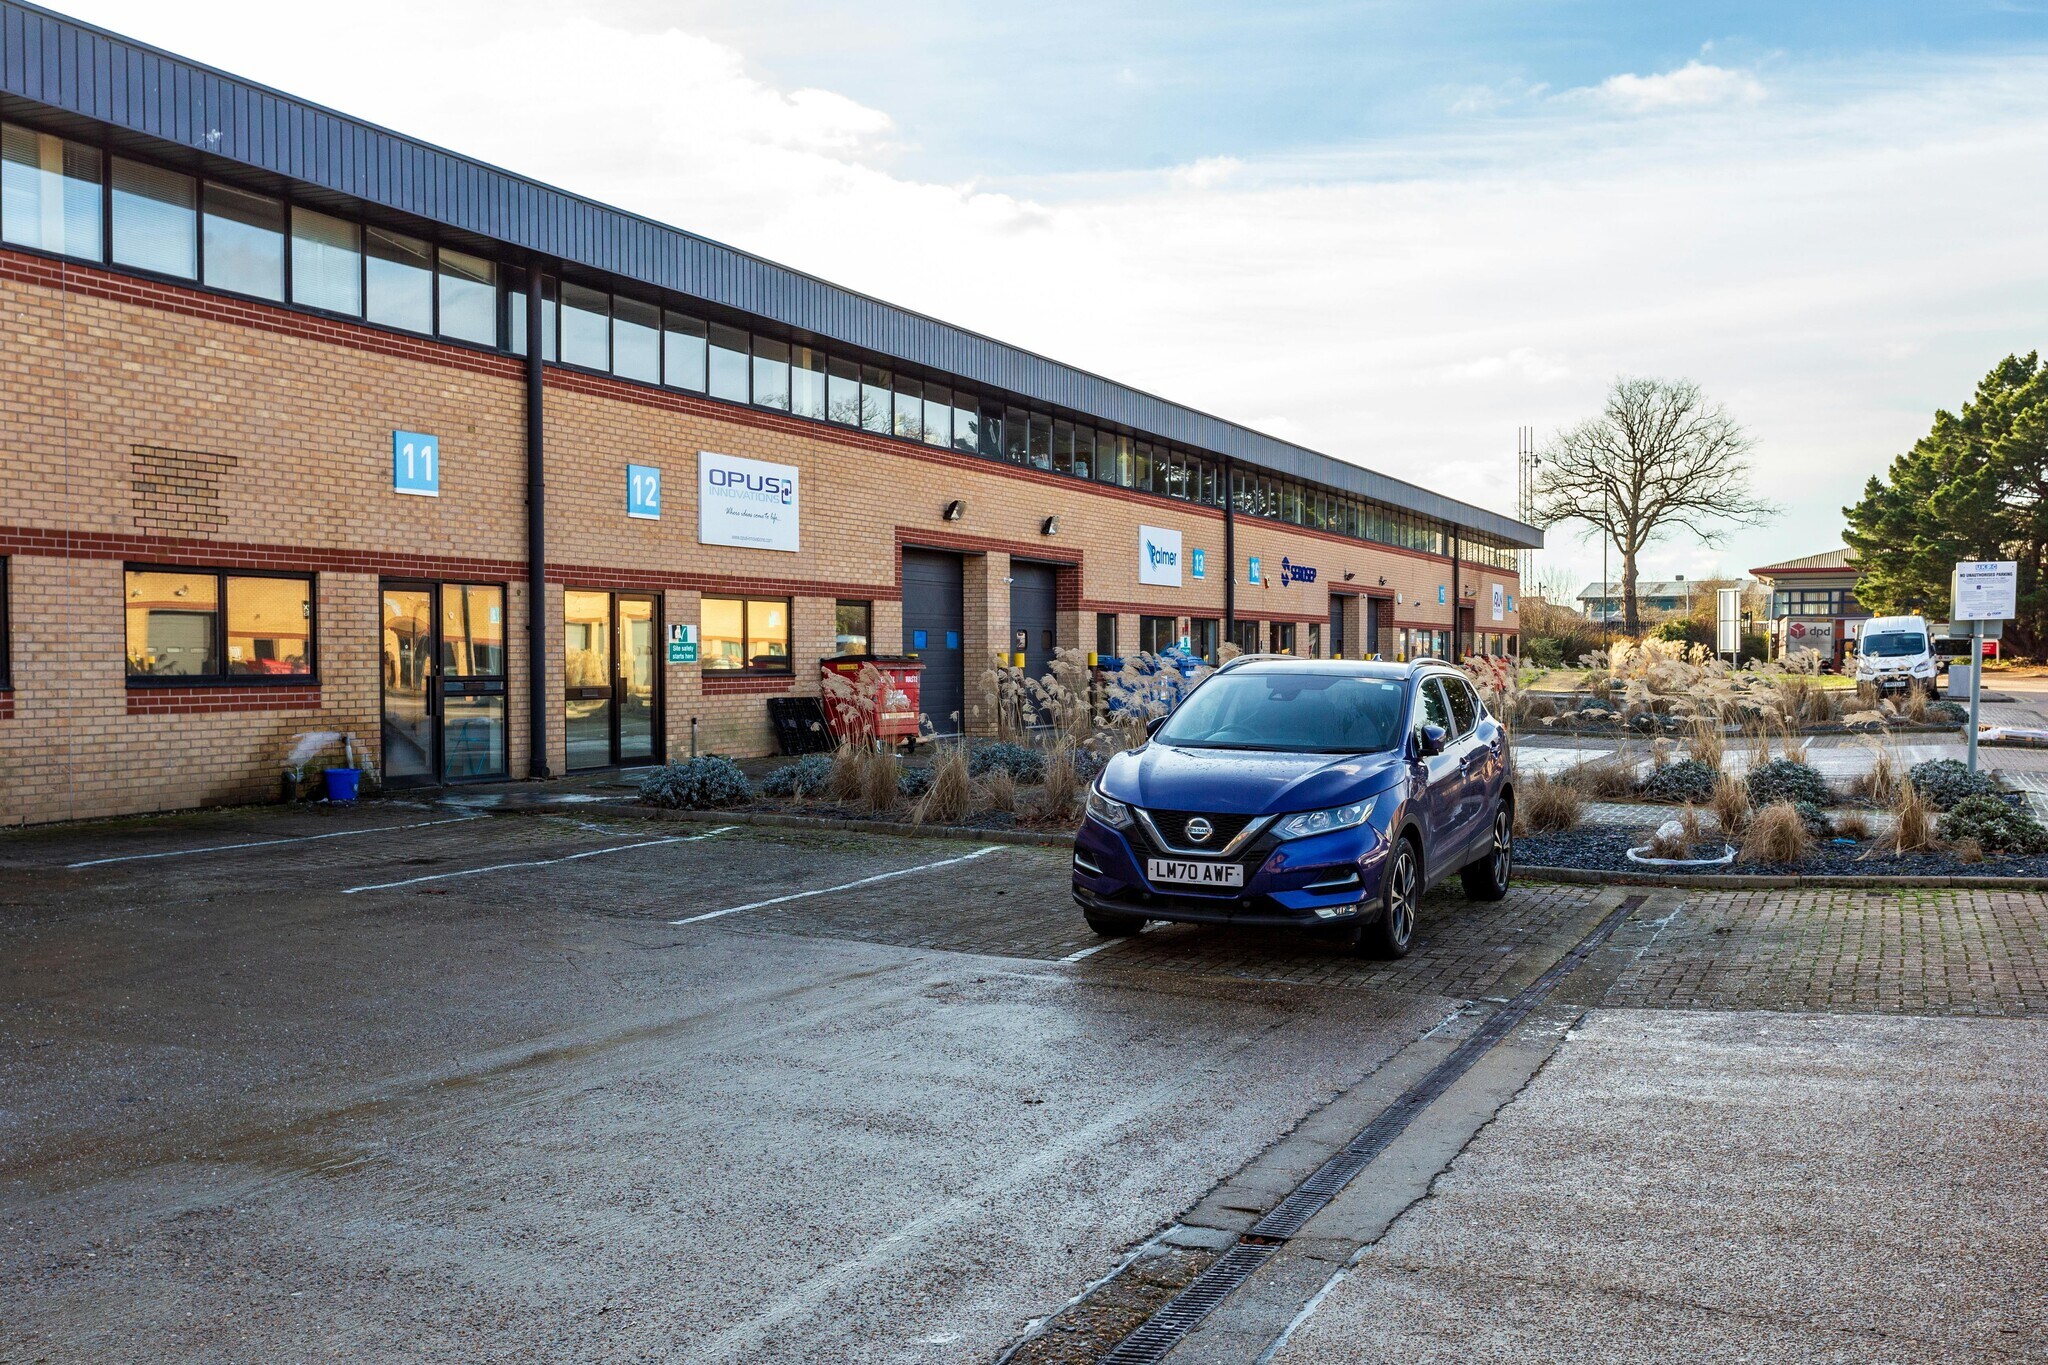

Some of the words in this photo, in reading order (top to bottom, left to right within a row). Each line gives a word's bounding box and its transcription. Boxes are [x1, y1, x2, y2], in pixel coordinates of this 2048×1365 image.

[403, 443, 432, 481] 11
[633, 474, 657, 507] 12
[709, 468, 780, 494] OPUS
[709, 486, 780, 504] INNOVATIONS
[1150, 545, 1177, 566] Palmer
[1195, 554, 1204, 572] 13
[1810, 626, 1831, 637] dpd
[681, 645, 694, 653] safety
[1156, 861, 1198, 880] LM70
[1203, 864, 1235, 882] AWF
